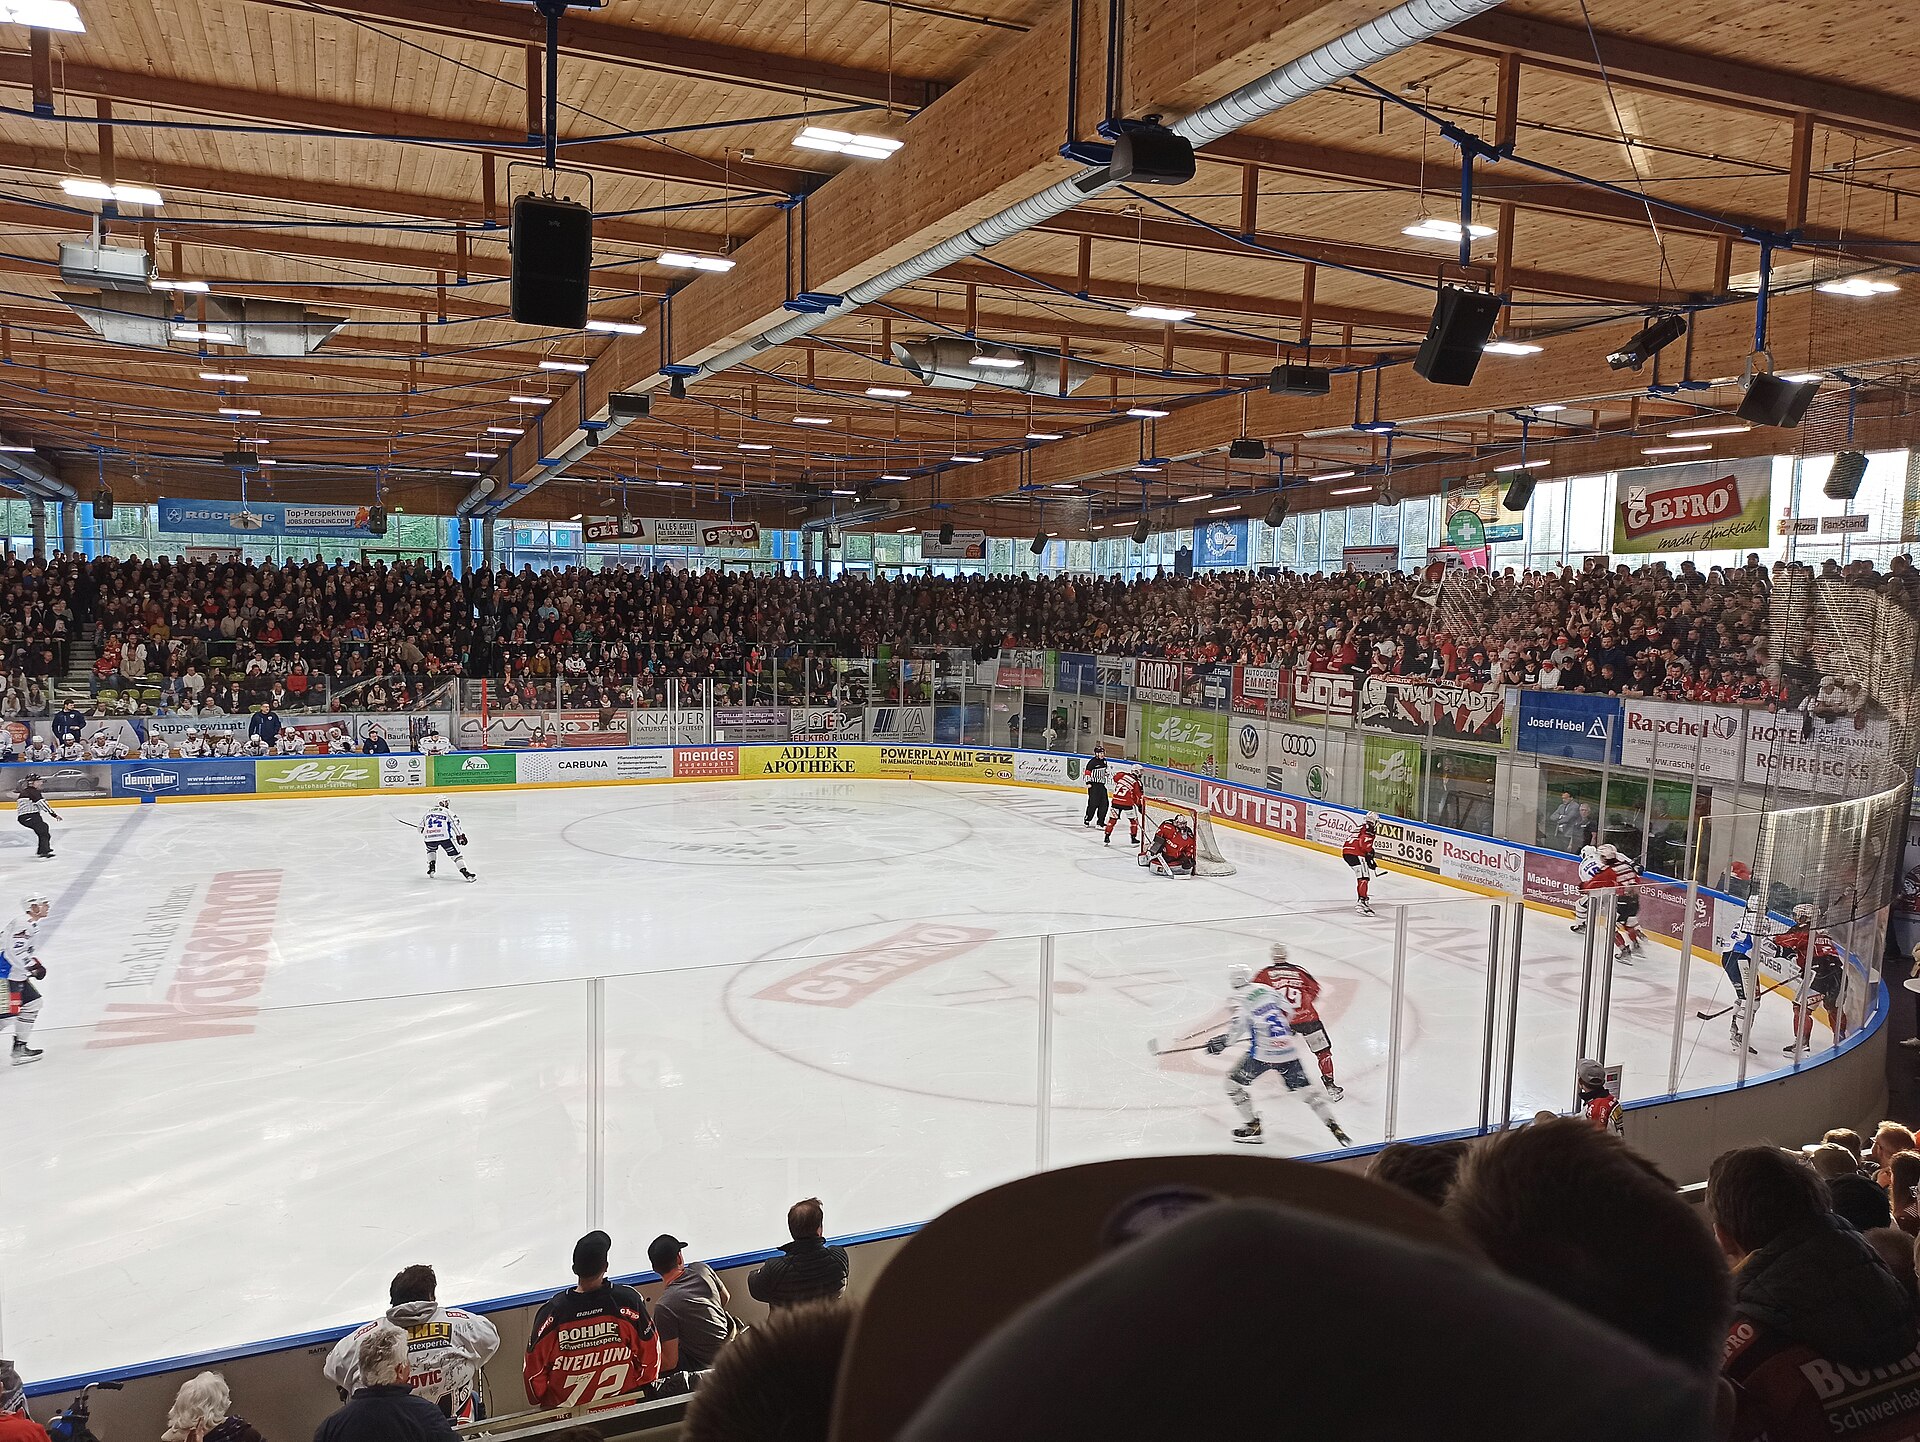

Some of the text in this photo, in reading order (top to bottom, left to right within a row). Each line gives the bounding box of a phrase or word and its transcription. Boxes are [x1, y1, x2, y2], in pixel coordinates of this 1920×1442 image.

[286, 509, 356, 518] Top-Perspektiven
[1627, 488, 1730, 529] GEFRO
[1700, 517, 1765, 550] glücklich!
[1245, 669, 1279, 678] AUTOCOLOR
[1244, 676, 1278, 689] EMMER
[152, 721, 194, 736] Suppe
[591, 720, 626, 732] PCK
[1527, 716, 1584, 732] Josef Hebel
[1628, 712, 1709, 738] Raschel
[832, 733, 860, 742] RAUCH
[679, 750, 735, 762] mendes
[781, 746, 838, 760] ADLER
[880, 748, 1014, 764] POWERPLAY MIT amz
[558, 760, 609, 769] CARBUNA
[678, 767, 735, 775] hörakustik
[763, 760, 856, 774] APOTHEKE
[887, 758, 925, 766] MEMMINGEN
[938, 760, 974, 768] MINDELHEIM
[124, 773, 177, 787] demmeler
[1142, 774, 1164, 792] uto
[1167, 777, 1199, 799] Thiel
[1207, 785, 1299, 833] KUTTER
[1316, 813, 1353, 833] Stölzle
[1375, 821, 1439, 848] TAXI Maier
[1374, 840, 1433, 864] 08331 3636
[1443, 841, 1502, 869] Raschel
[1527, 872, 1561, 889] Macher
[1640, 885, 1656, 897] GPS
[131, 922, 181, 939] des
[84, 868, 285, 1050] Wassermann
[104, 963, 162, 990] Ihre
[552, 1346, 632, 1371] SVEDLUND
[557, 1363, 630, 1408] 72
